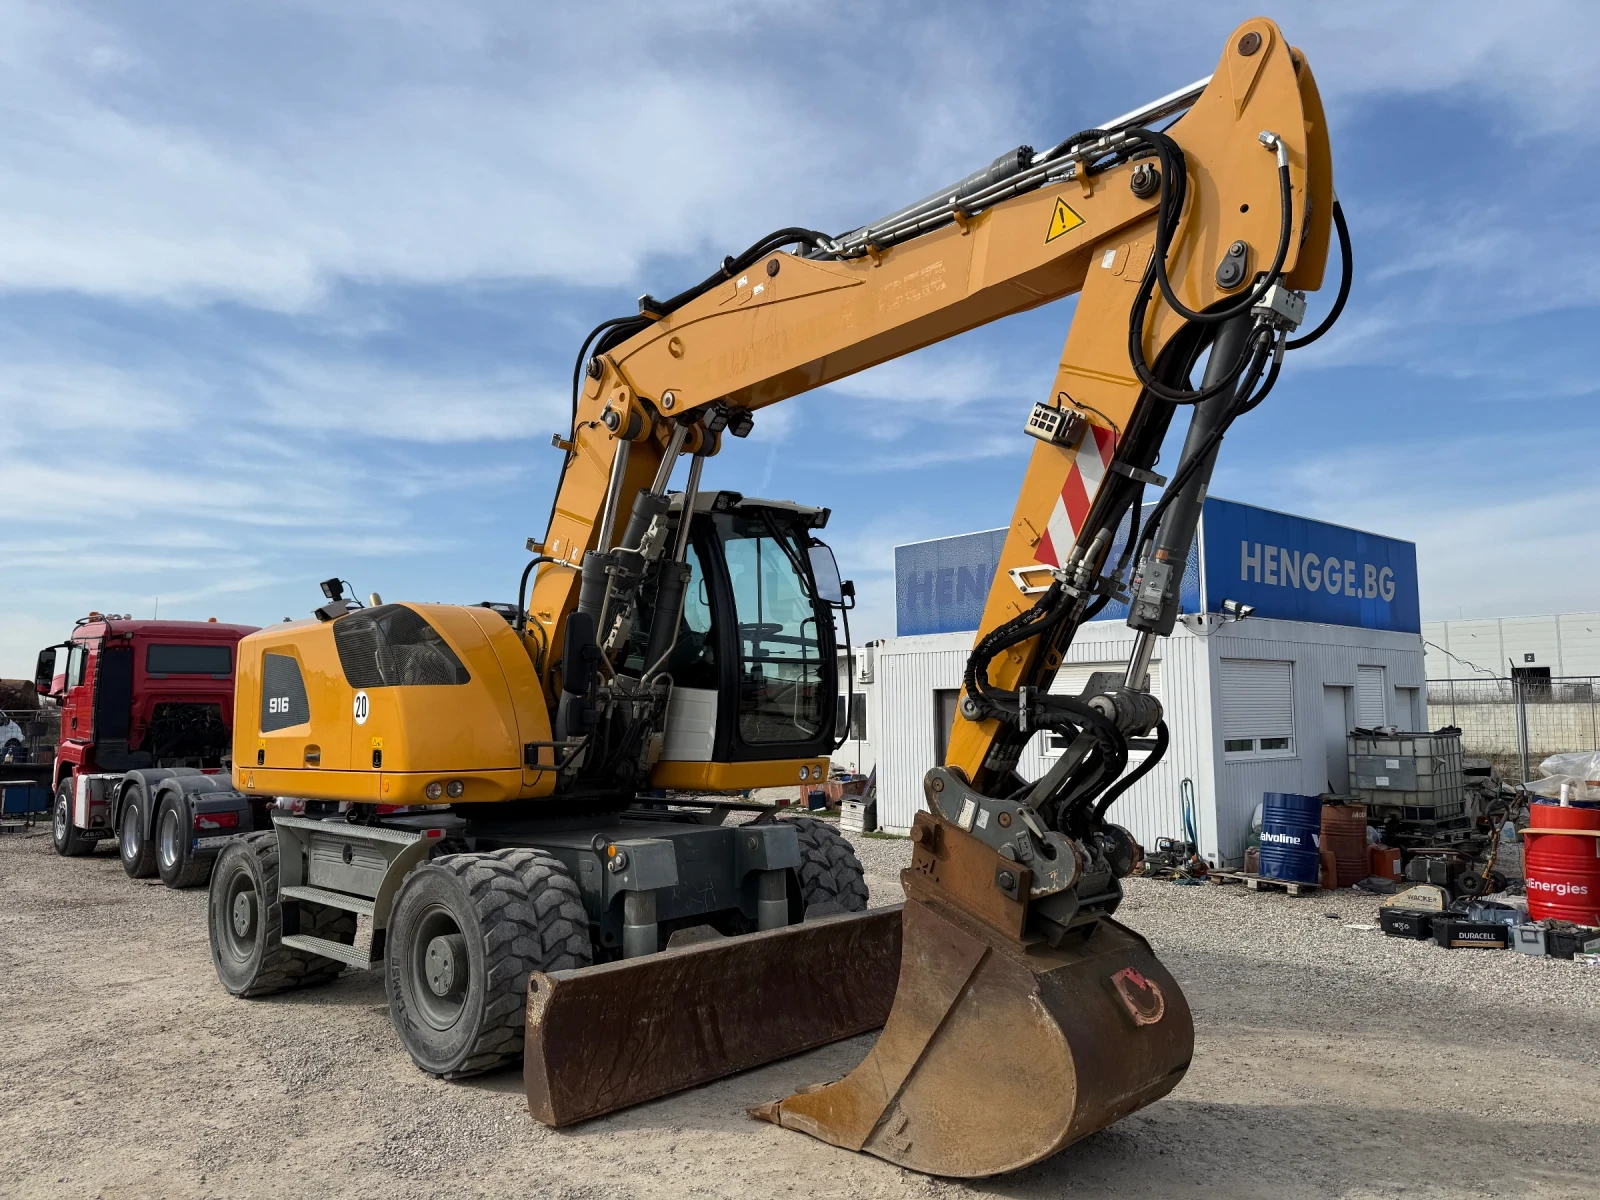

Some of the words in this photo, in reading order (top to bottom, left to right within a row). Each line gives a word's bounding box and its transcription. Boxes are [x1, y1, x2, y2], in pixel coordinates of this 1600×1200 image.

[1240, 540, 1396, 602] HENGGE.BG
[269, 697, 289, 713] 916
[355, 695, 367, 718] 20
[1407, 894, 1438, 903] WACKER
[1458, 932, 1496, 940] DURACELL
